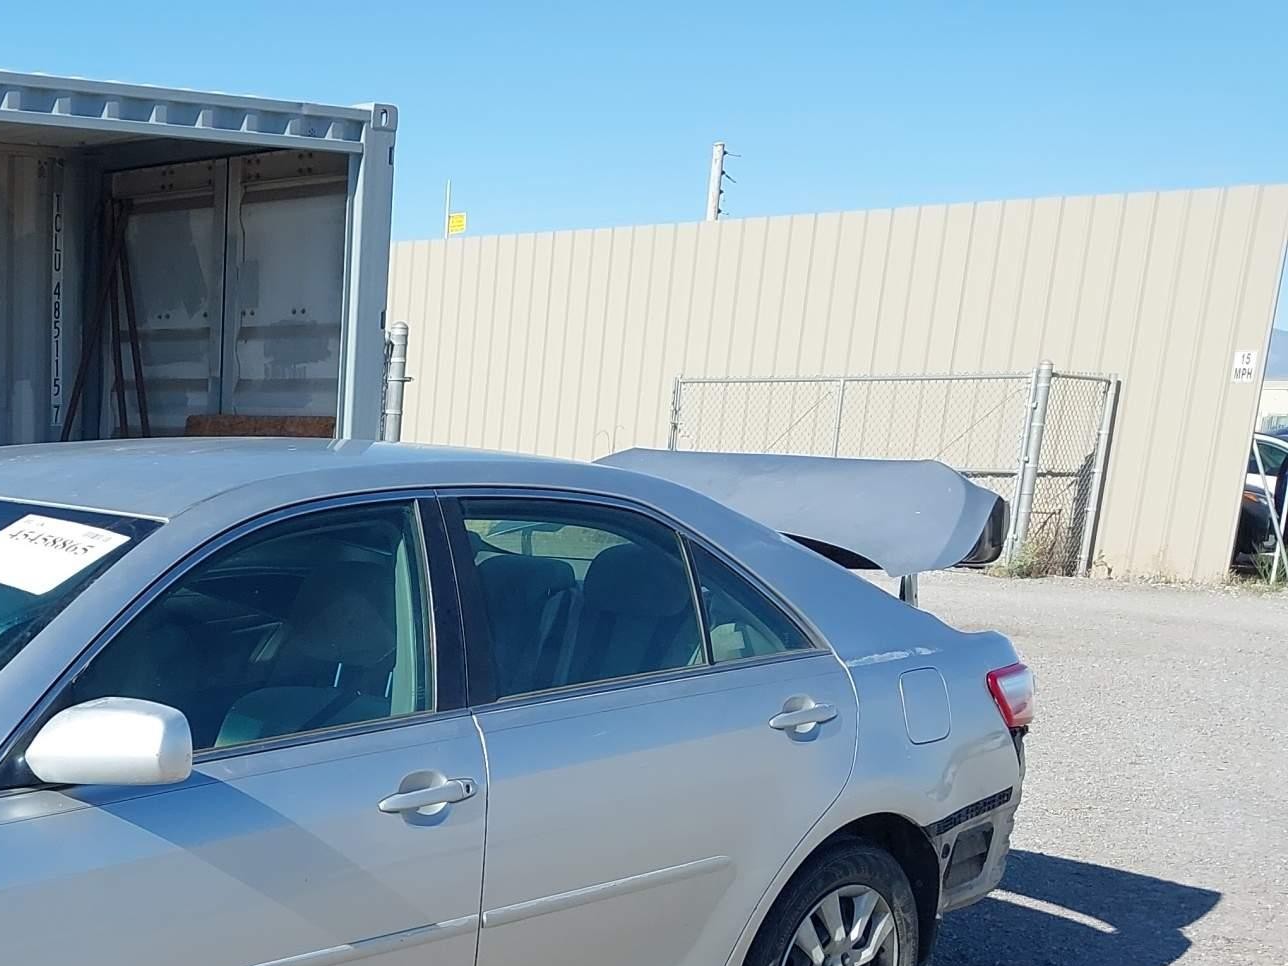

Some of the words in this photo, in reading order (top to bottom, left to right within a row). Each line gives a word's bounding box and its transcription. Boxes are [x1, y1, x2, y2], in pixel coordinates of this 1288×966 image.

[53, 281, 61, 397] 485115
[1241, 353, 1252, 365] 15
[1233, 367, 1253, 379] MPH
[53, 405, 61, 424] 7
[9, 529, 94, 555] 45458865
